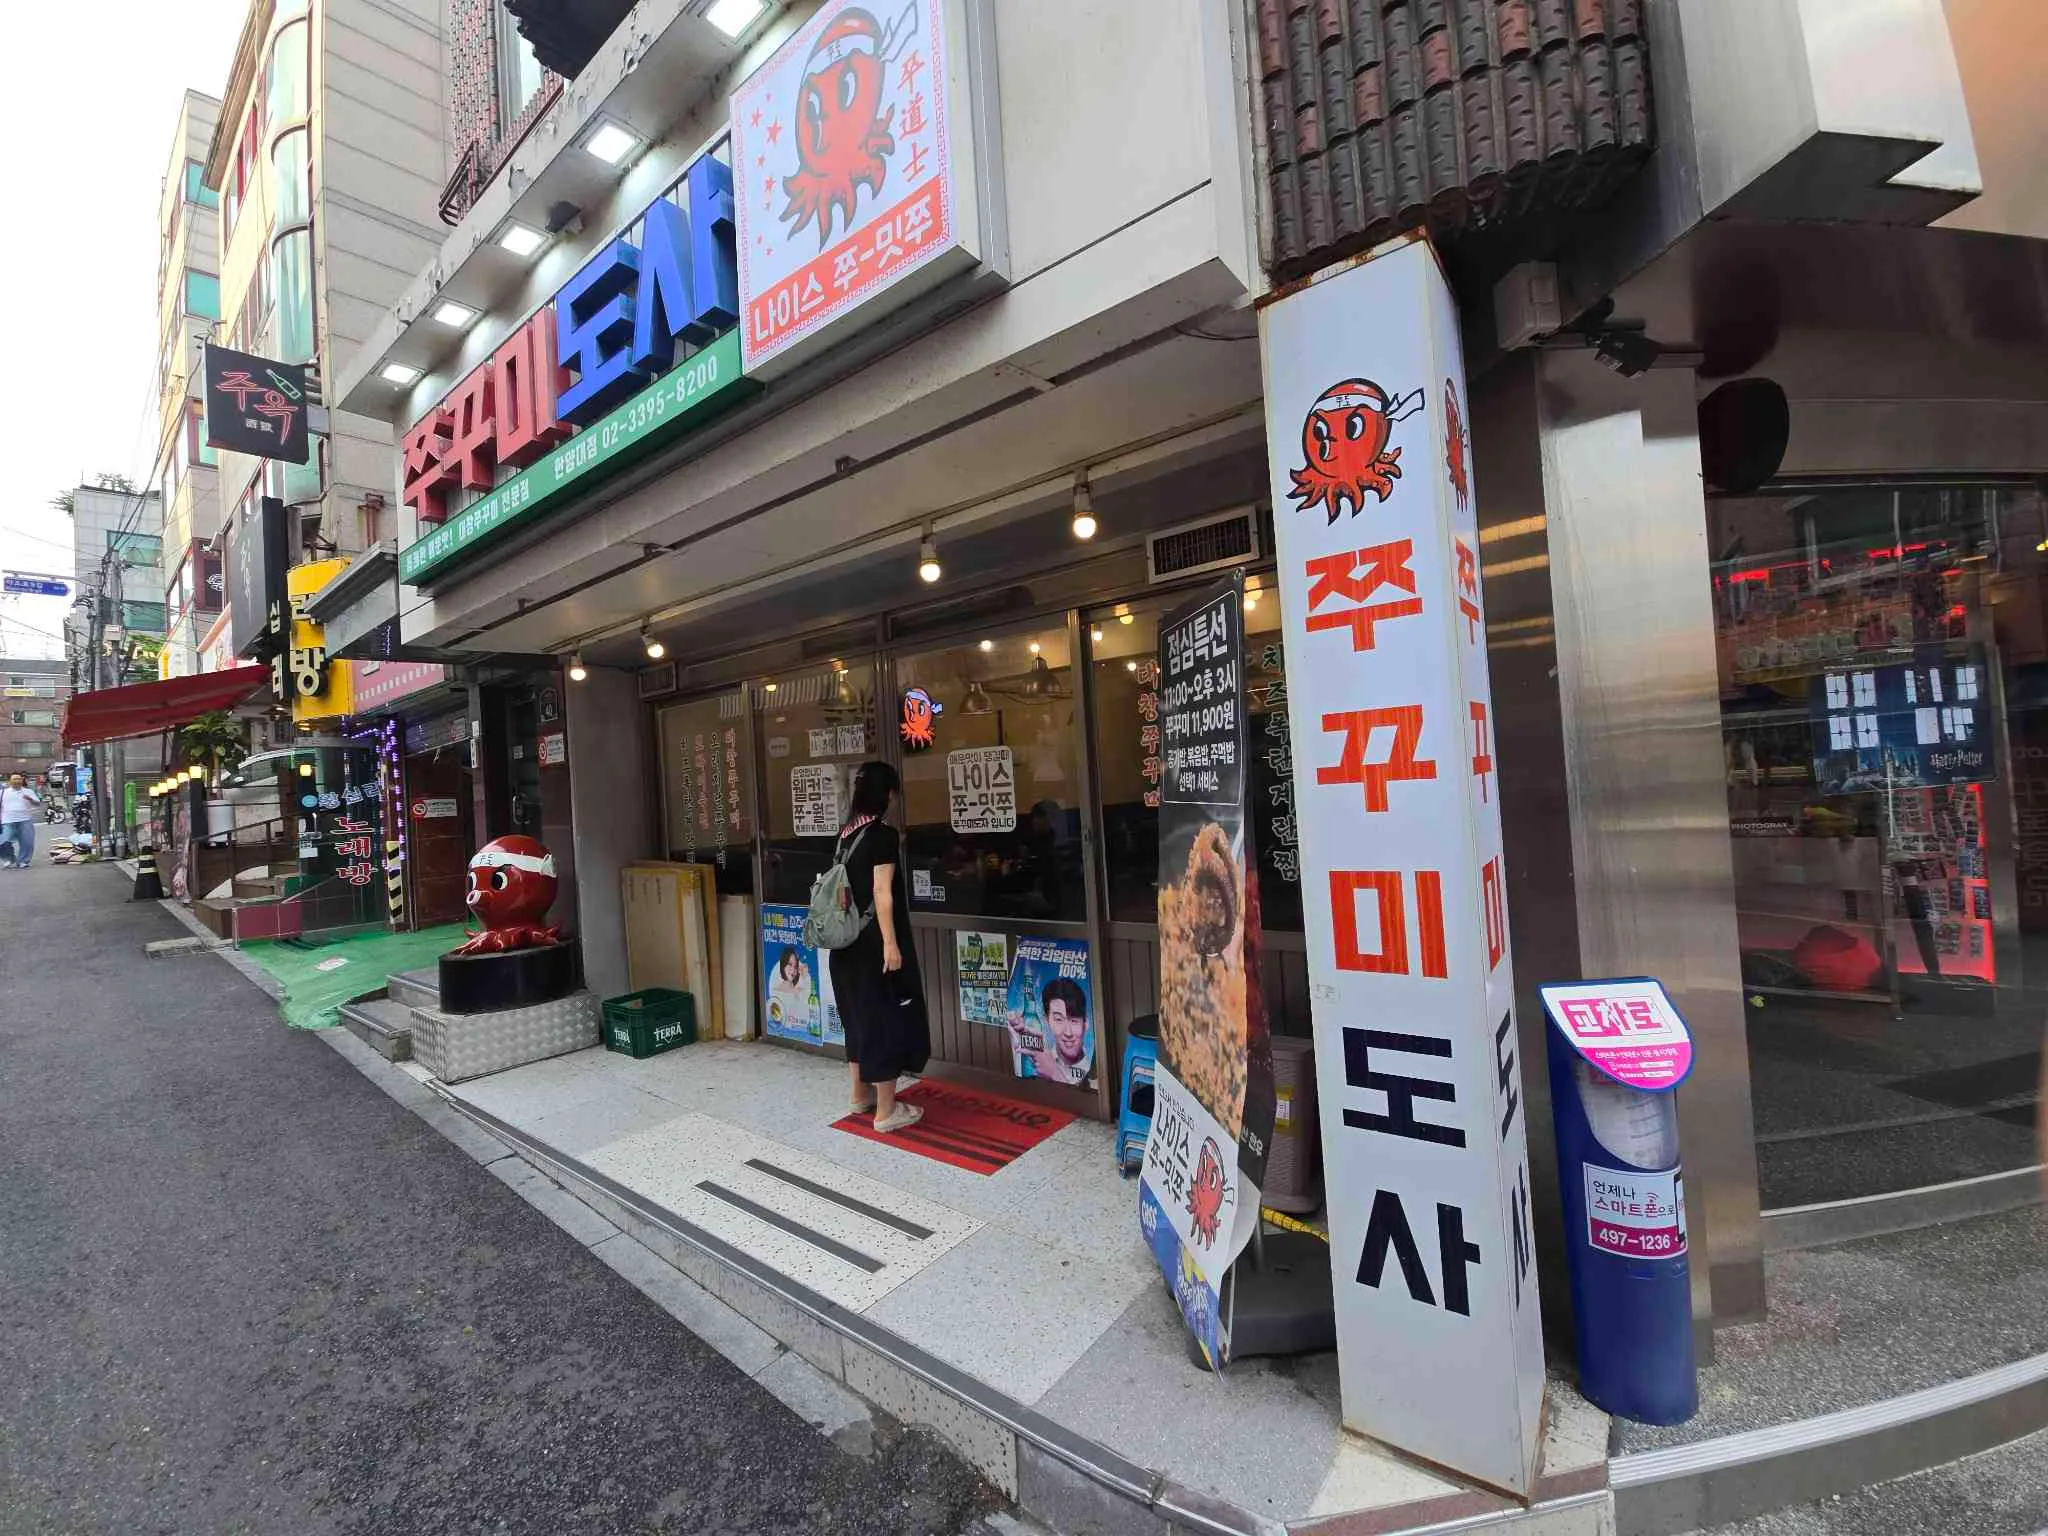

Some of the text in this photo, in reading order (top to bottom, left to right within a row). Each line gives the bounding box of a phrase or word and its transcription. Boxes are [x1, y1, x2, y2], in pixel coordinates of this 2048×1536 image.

[754, 271, 826, 343] 나이스
[501, 478, 529, 514] 전문점
[602, 354, 718, 450] 02-3395-8200
[1167, 603, 1228, 675] 점심특선
[1163, 659, 1237, 712] 11:00~오후 3시
[1165, 699, 1235, 741] 쭈꾸미 11,900원
[950, 763, 1012, 792] 나이스
[1198, 770, 1219, 792] 서비스
[990, 816, 1015, 829] 입니다
[330, 816, 378, 885] 노래방
[1304, 538, 1482, 1319] 쭈꾸미도사
[1058, 963, 1087, 979] 100%
[653, 1021, 683, 1042] TERRA
[1567, 1000, 1664, 1033] 교차로
[1156, 1100, 1190, 1169] 나이스
[1593, 1180, 1637, 1201] 언제나
[1594, 1197, 1676, 1218] 스마트폰으로
[1599, 1227, 1671, 1250] 497-1236
